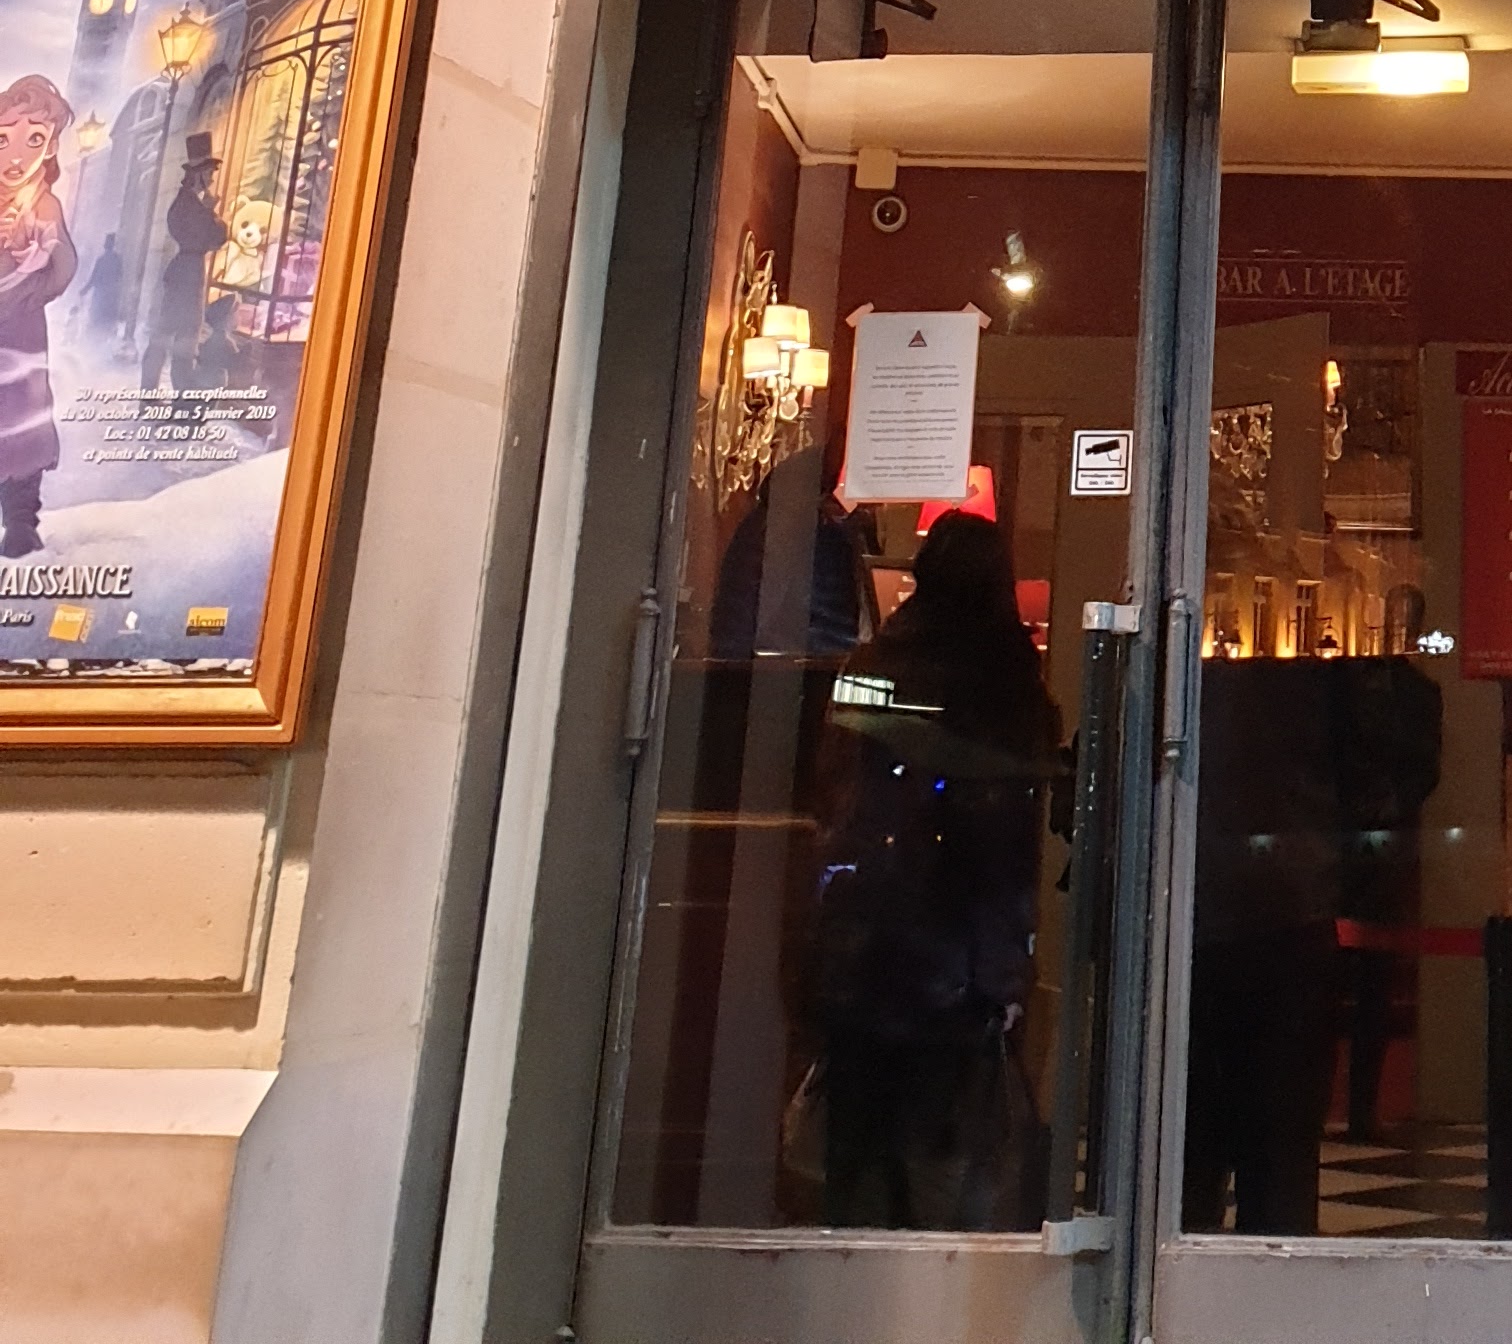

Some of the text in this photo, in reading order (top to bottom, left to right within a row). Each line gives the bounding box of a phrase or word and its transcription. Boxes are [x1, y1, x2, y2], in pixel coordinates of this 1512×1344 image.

[181, 385, 269, 403] exceptionnelles
[142, 405, 173, 420] 2018
[244, 404, 277, 420] 2019
[0, 564, 134, 598] AISSANCE
